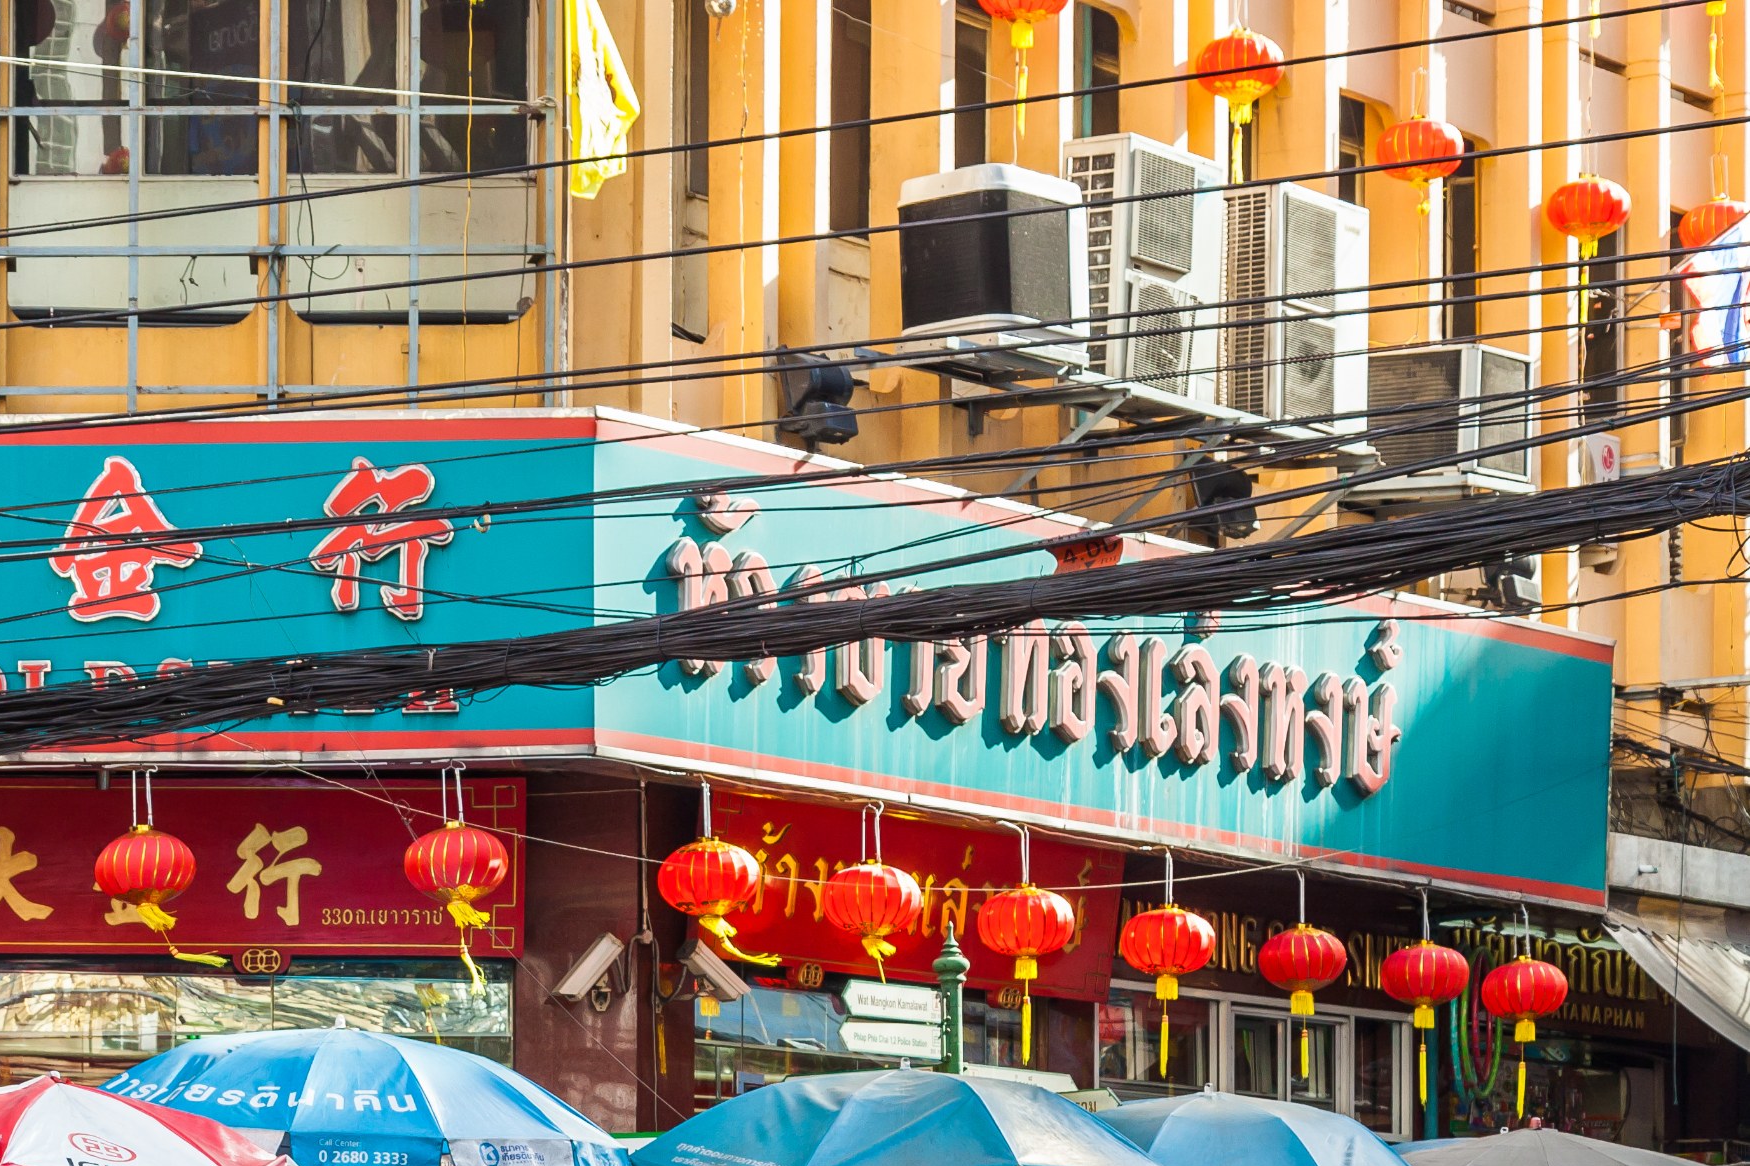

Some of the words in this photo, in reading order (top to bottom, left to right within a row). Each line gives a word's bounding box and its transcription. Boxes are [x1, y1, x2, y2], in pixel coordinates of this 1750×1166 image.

[858, 994, 869, 1005] Wat
[871, 996, 895, 1010] Mangkon
[912, 1038, 928, 1048] Station
[319, 1138, 332, 1147] Call
[335, 1138, 361, 1148] Center:
[319, 1151, 327, 1162] 0
[332, 1151, 368, 1164] 2680
[372, 1152, 409, 1166] 3333
